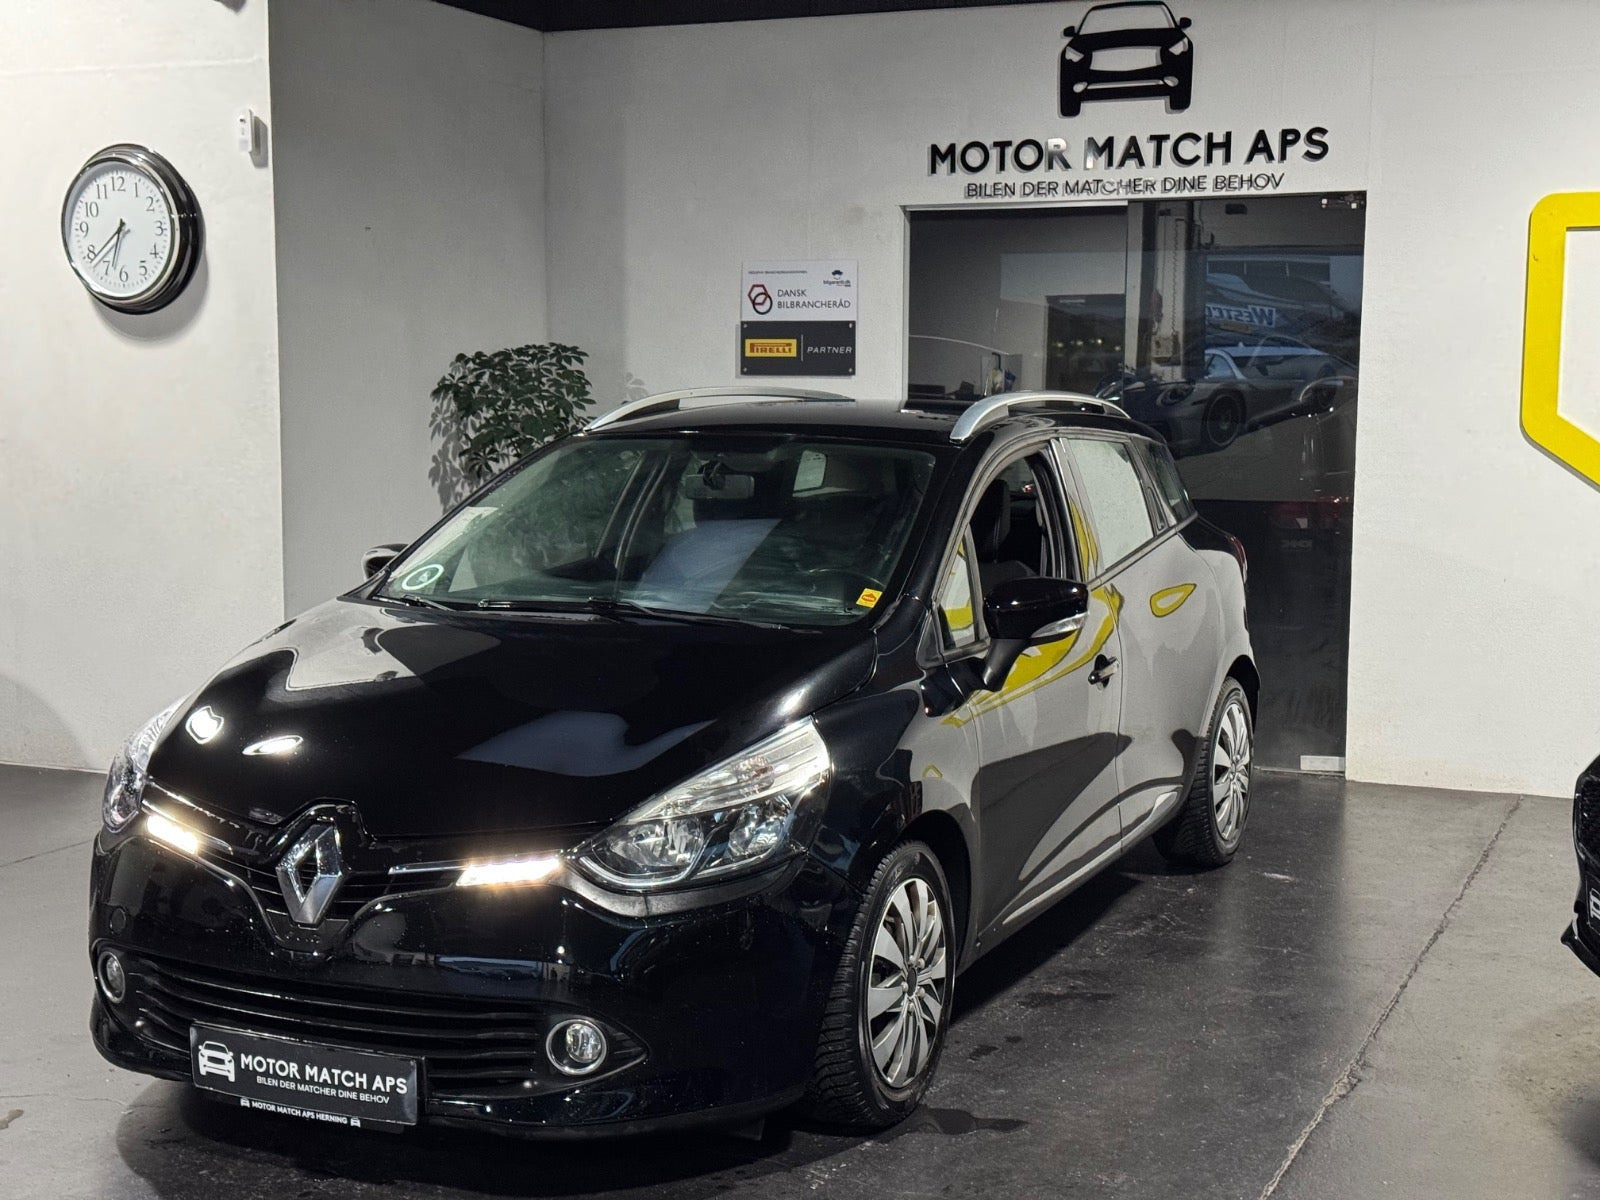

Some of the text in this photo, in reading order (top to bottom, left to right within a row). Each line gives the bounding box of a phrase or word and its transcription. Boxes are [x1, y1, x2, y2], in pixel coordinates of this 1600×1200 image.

[930, 126, 1329, 175] MOTOR MATCH APS
[96, 183, 108, 200] 11
[111, 176, 126, 192] 12
[134, 182, 139, 198] 1
[967, 173, 1285, 197] BILEN DER MATCHER DINE BEHOV
[85, 201, 99, 218] 10
[145, 196, 155, 212] 2
[79, 221, 89, 238] 9
[154, 220, 164, 236] 3
[149, 243, 159, 259] 4
[103, 260, 111, 276] 7
[119, 264, 129, 282] 6
[139, 260, 148, 277] 5
[777, 289, 807, 298] DANSK
[777, 299, 851, 309] BILBRANCHERÅD
[749, 342, 852, 354] PIRELLI PARTNER
[241, 1053, 408, 1095] MOTOR MATCH APS
[256, 1075, 390, 1104] BILEN DER MATCHER DINE BEHOV
[252, 1101, 348, 1125] MOTOR MATCH APS HERNING
